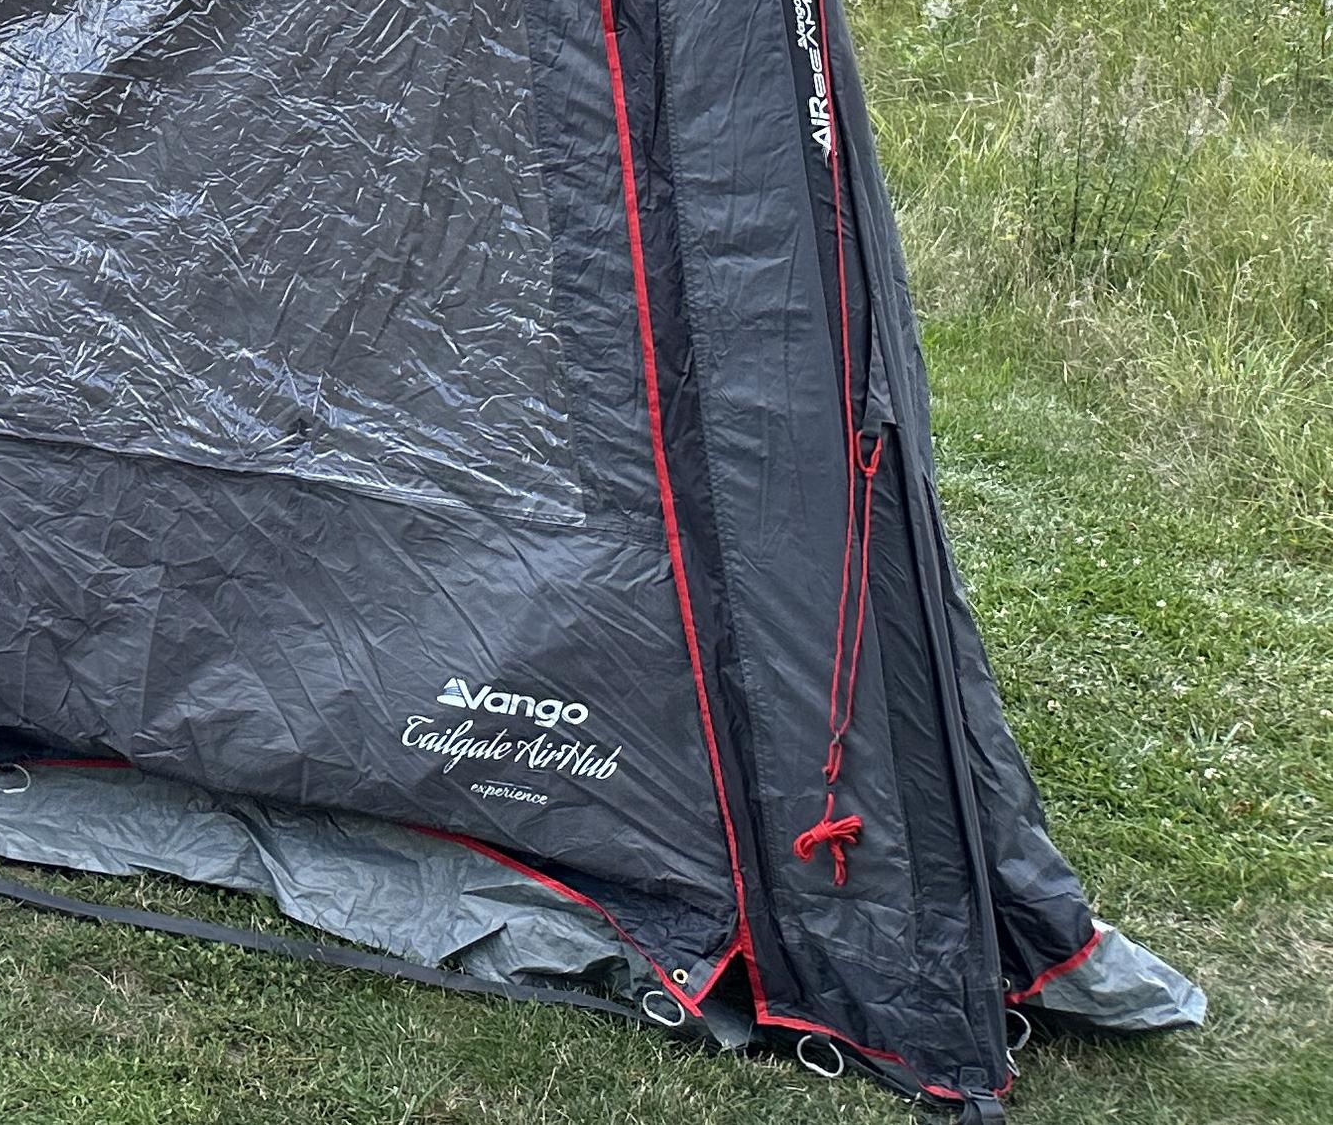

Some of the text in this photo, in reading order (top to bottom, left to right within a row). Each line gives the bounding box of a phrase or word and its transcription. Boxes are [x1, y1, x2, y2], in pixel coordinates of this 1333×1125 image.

[456, 678, 589, 728] Vango
[401, 715, 623, 781] Tailgate AirHub
[470, 781, 548, 805] experience
